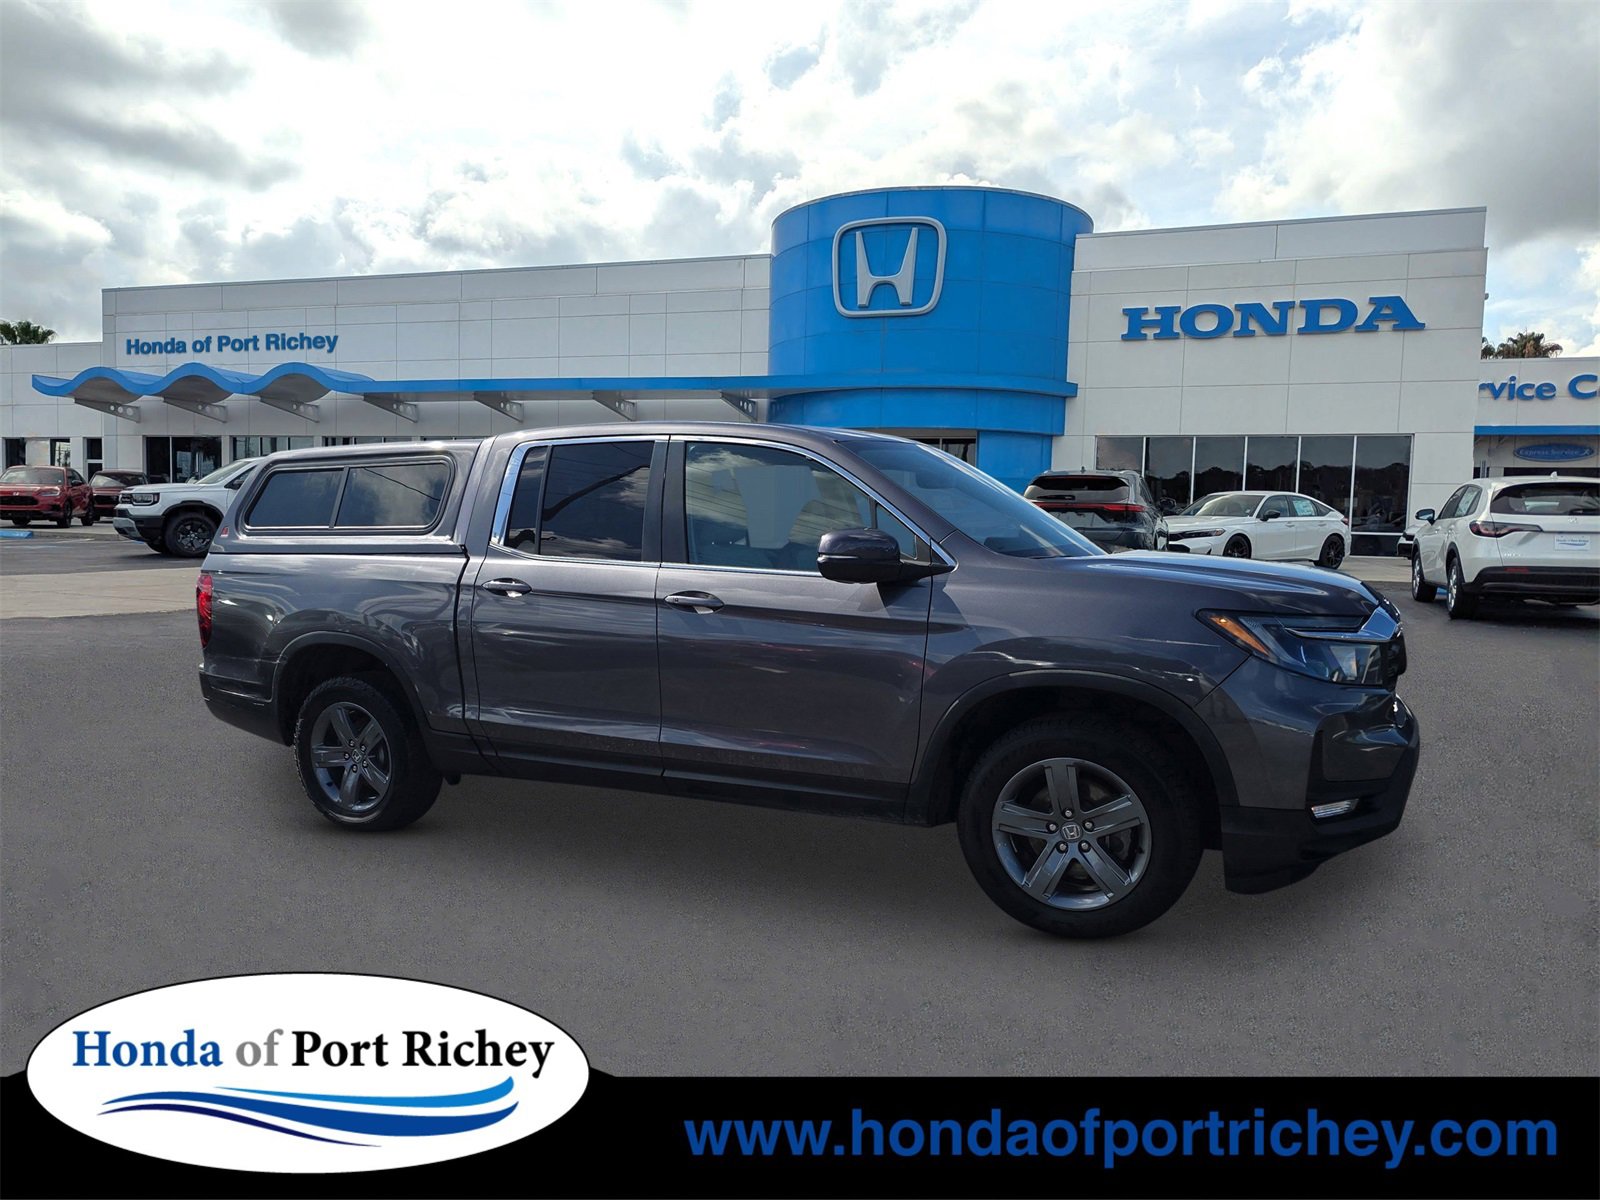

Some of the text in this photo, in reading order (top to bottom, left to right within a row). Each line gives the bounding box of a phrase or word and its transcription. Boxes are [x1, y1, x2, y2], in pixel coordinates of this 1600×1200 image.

[1120, 295, 1426, 341] HONDA
[125, 331, 339, 356] Honda of Port Richey
[1567, 373, 1600, 400] C
